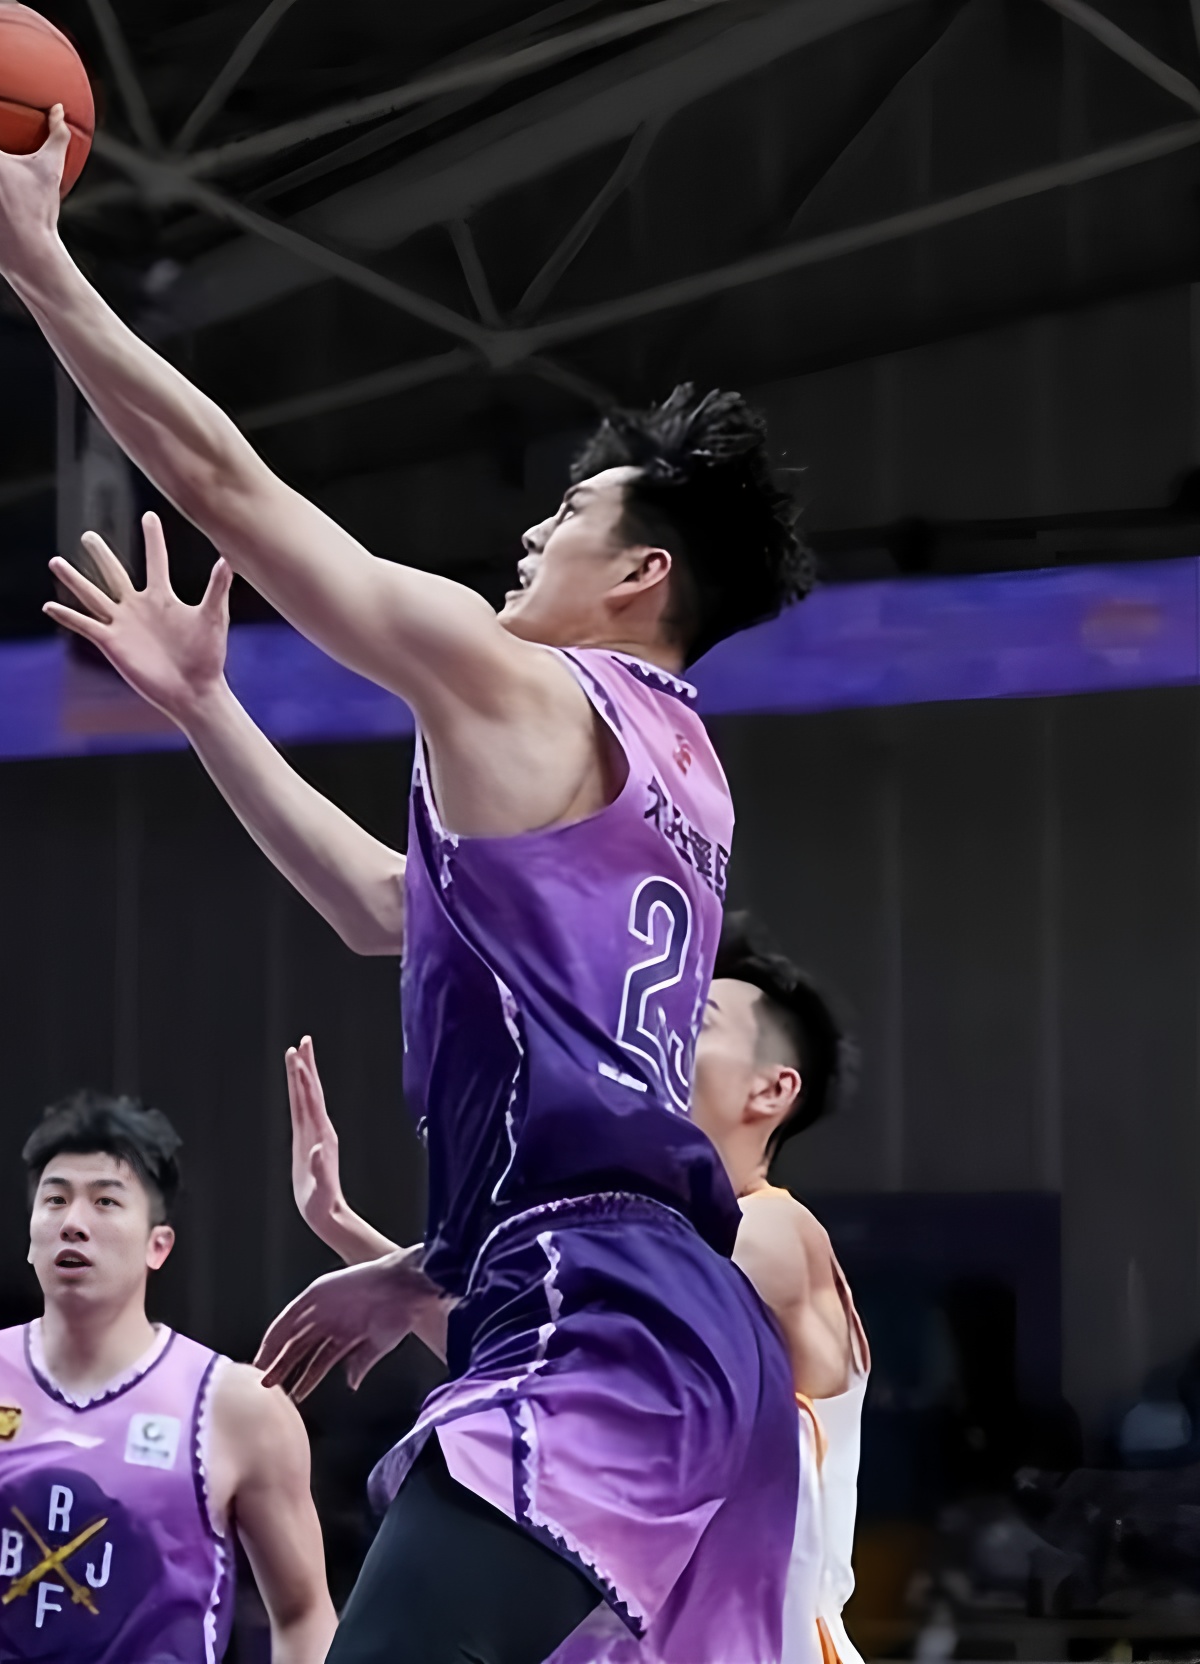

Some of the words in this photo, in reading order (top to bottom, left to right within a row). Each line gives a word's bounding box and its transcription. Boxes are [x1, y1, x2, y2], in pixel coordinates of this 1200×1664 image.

[48, 1484, 74, 1533] R
[85, 1541, 113, 1589] J
[35, 1582, 65, 1628] F
